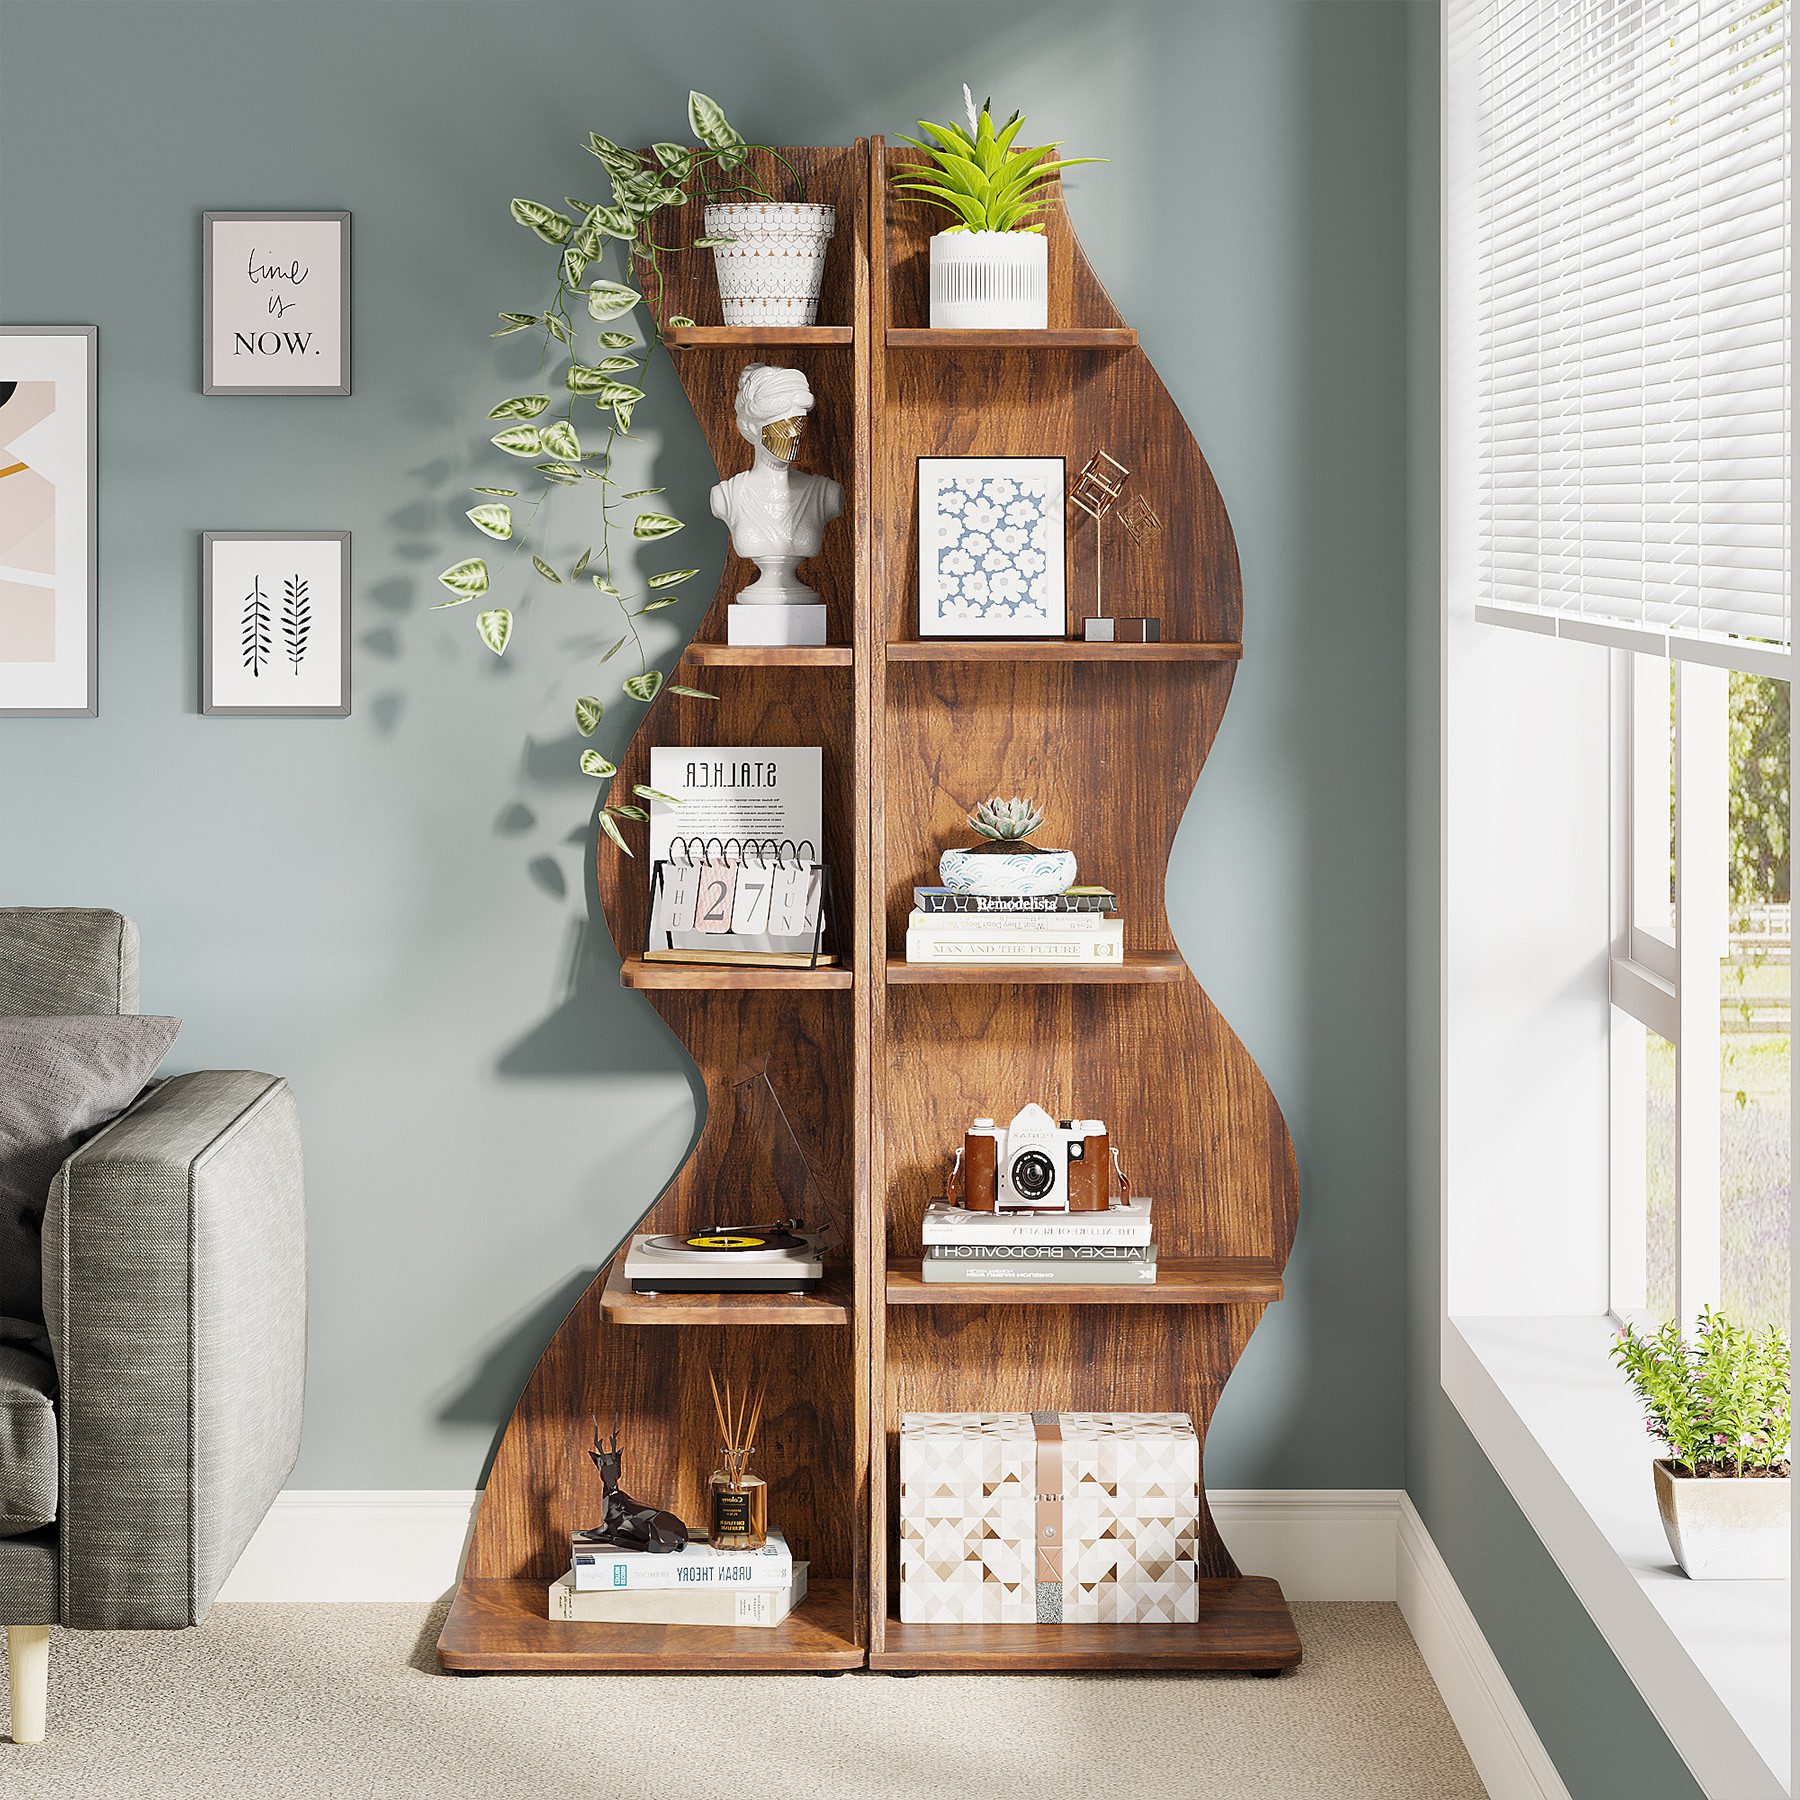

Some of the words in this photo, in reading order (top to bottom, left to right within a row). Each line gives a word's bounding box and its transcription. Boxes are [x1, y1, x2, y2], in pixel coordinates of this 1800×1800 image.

[247, 248, 308, 285] time
[269, 289, 295, 318] is
[233, 331, 320, 356] NOW.
[977, 895, 1058, 911] Remodelista
[934, 943, 962, 955] MAN
[967, 943, 996, 955] AND
[1000, 943, 1026, 955] THE
[1030, 943, 1081, 955] FUTURE
